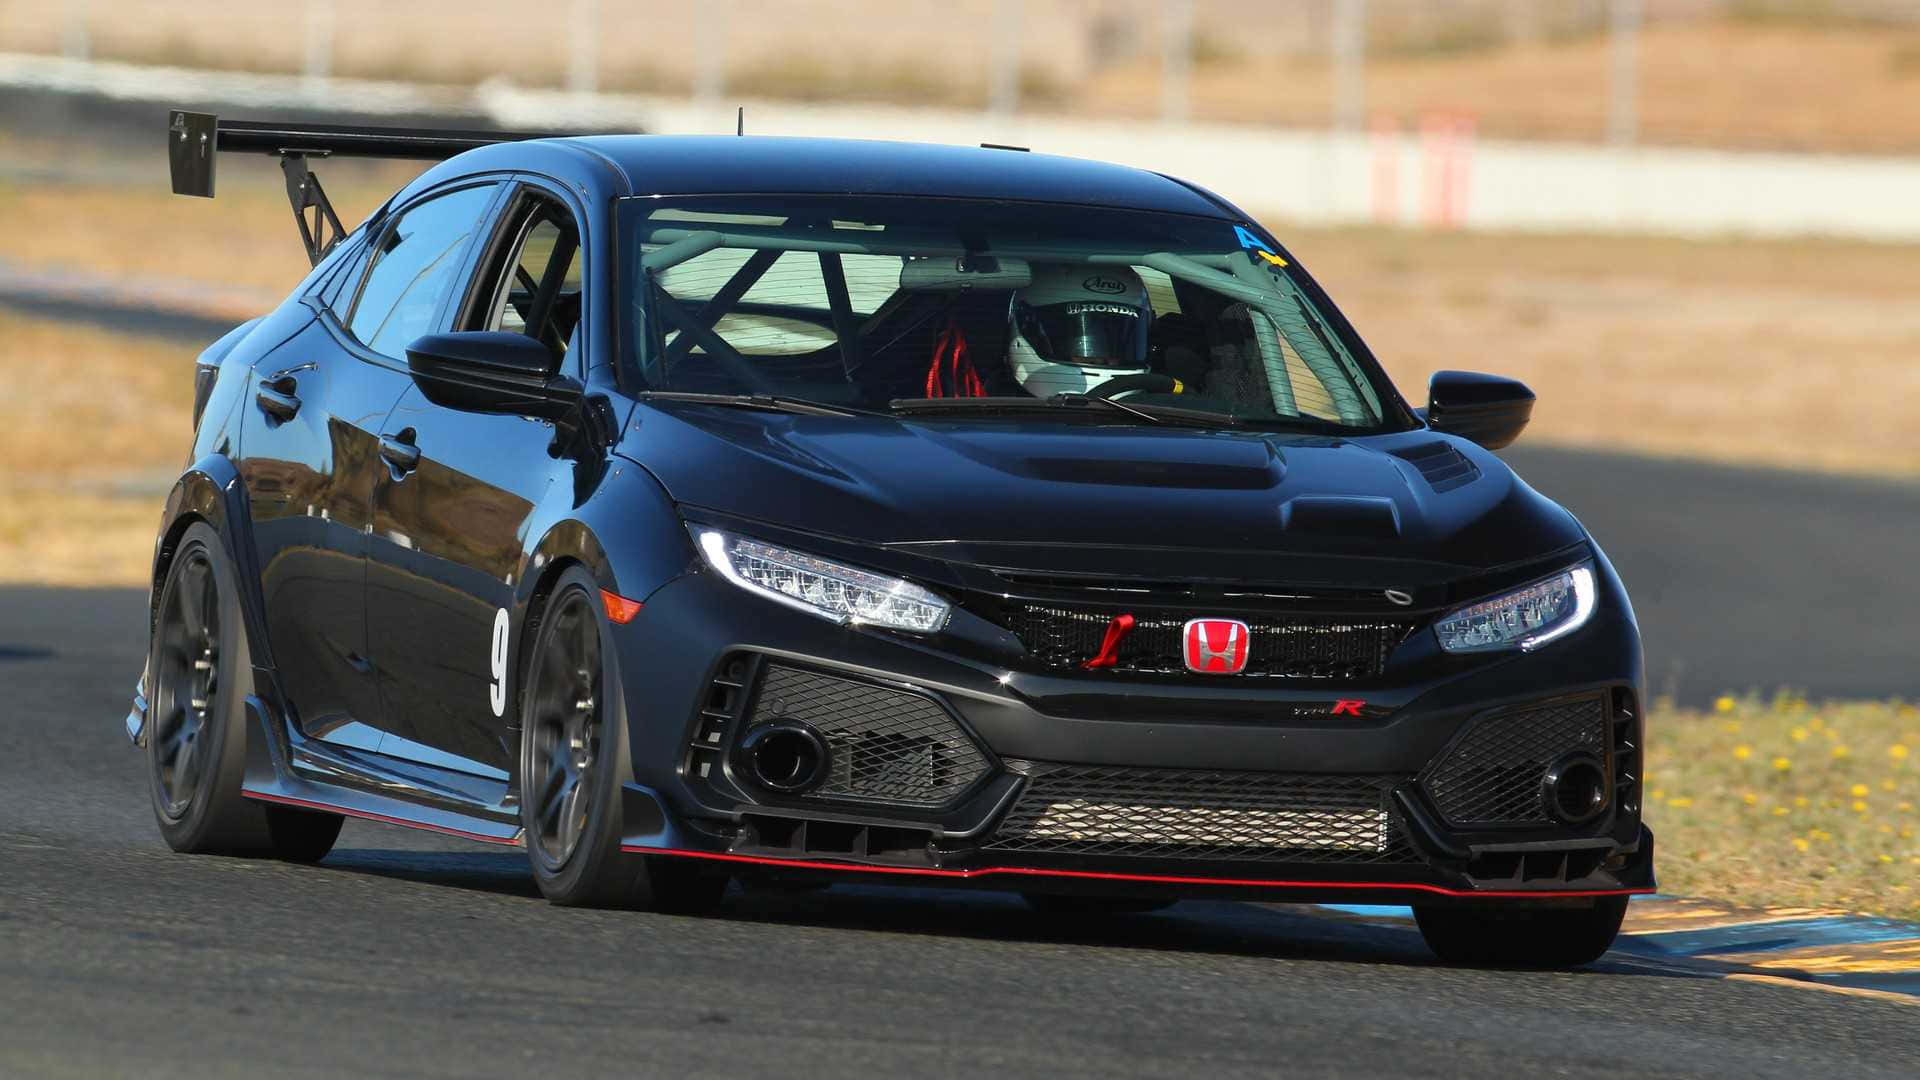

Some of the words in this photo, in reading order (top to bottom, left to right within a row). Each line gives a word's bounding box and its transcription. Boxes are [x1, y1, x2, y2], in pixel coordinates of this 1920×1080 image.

[1081, 304, 1139, 318] HONDA
[490, 607, 509, 717] 9
[1331, 698, 1367, 716] R
